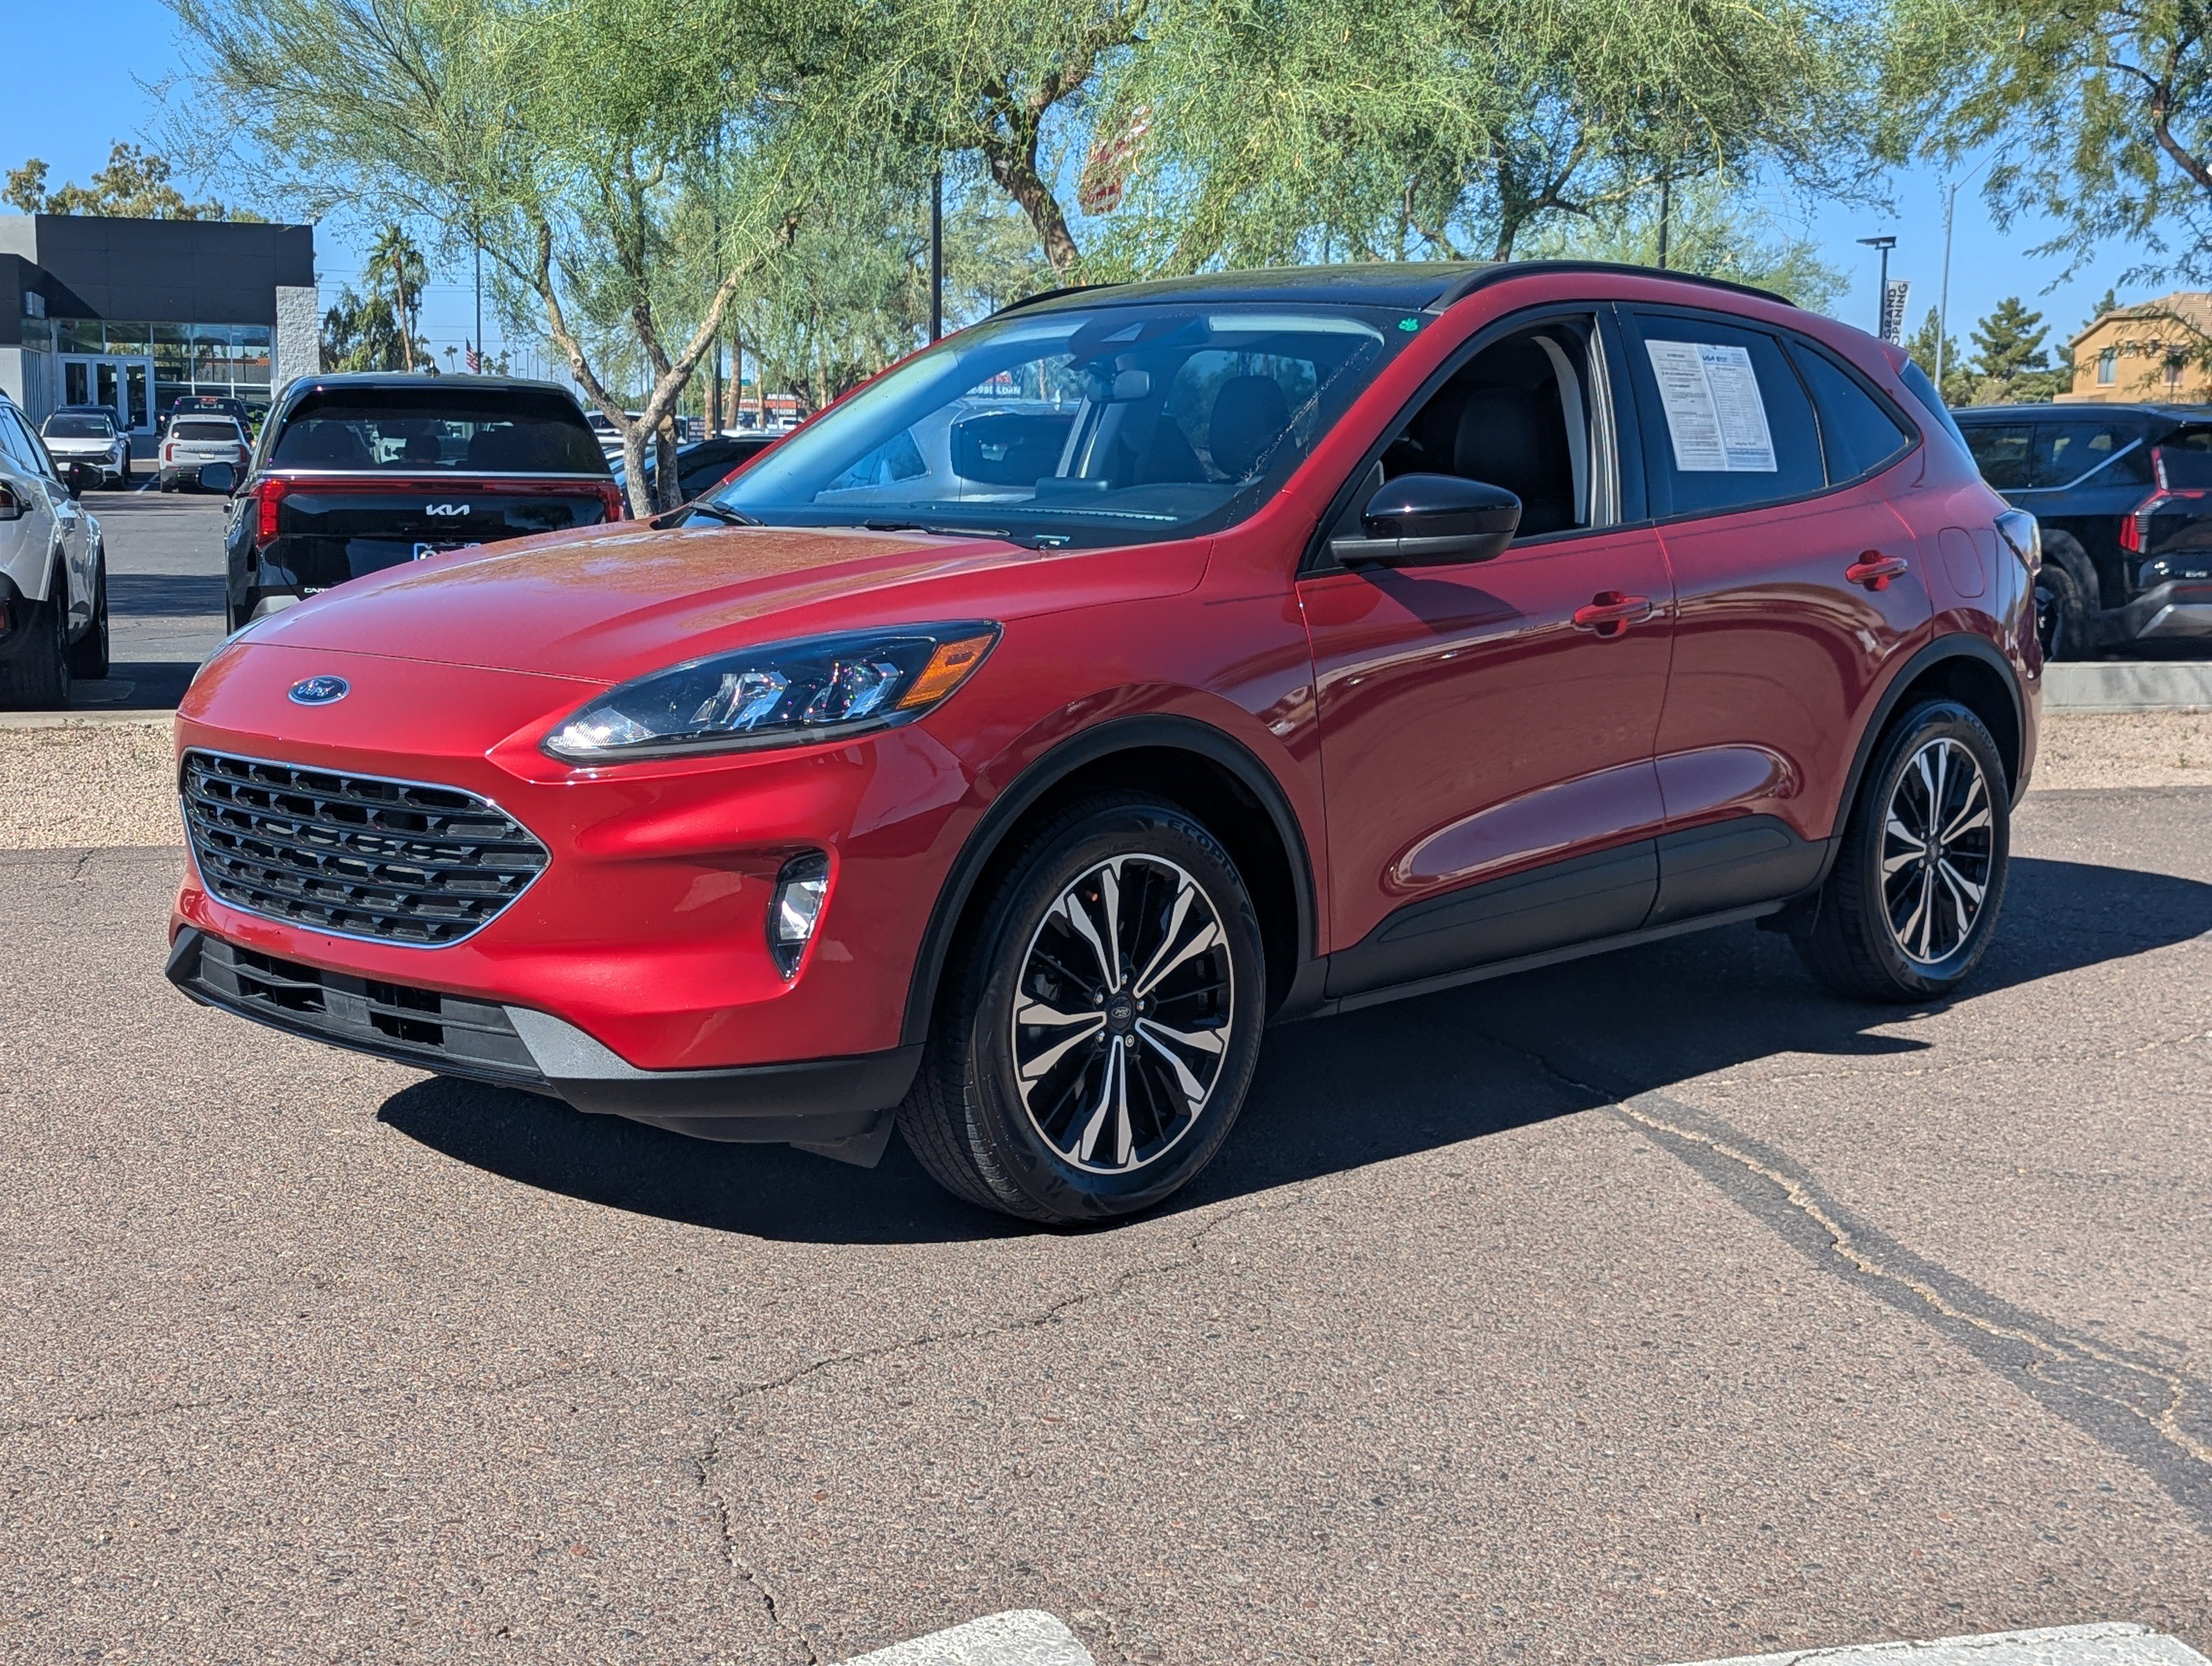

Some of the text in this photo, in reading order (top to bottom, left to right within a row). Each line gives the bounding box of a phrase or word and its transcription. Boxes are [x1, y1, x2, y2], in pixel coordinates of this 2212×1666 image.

[1884, 289, 1896, 339] GRAND
[1892, 283, 1908, 345] OPENING
[426, 504, 470, 516] KIA
